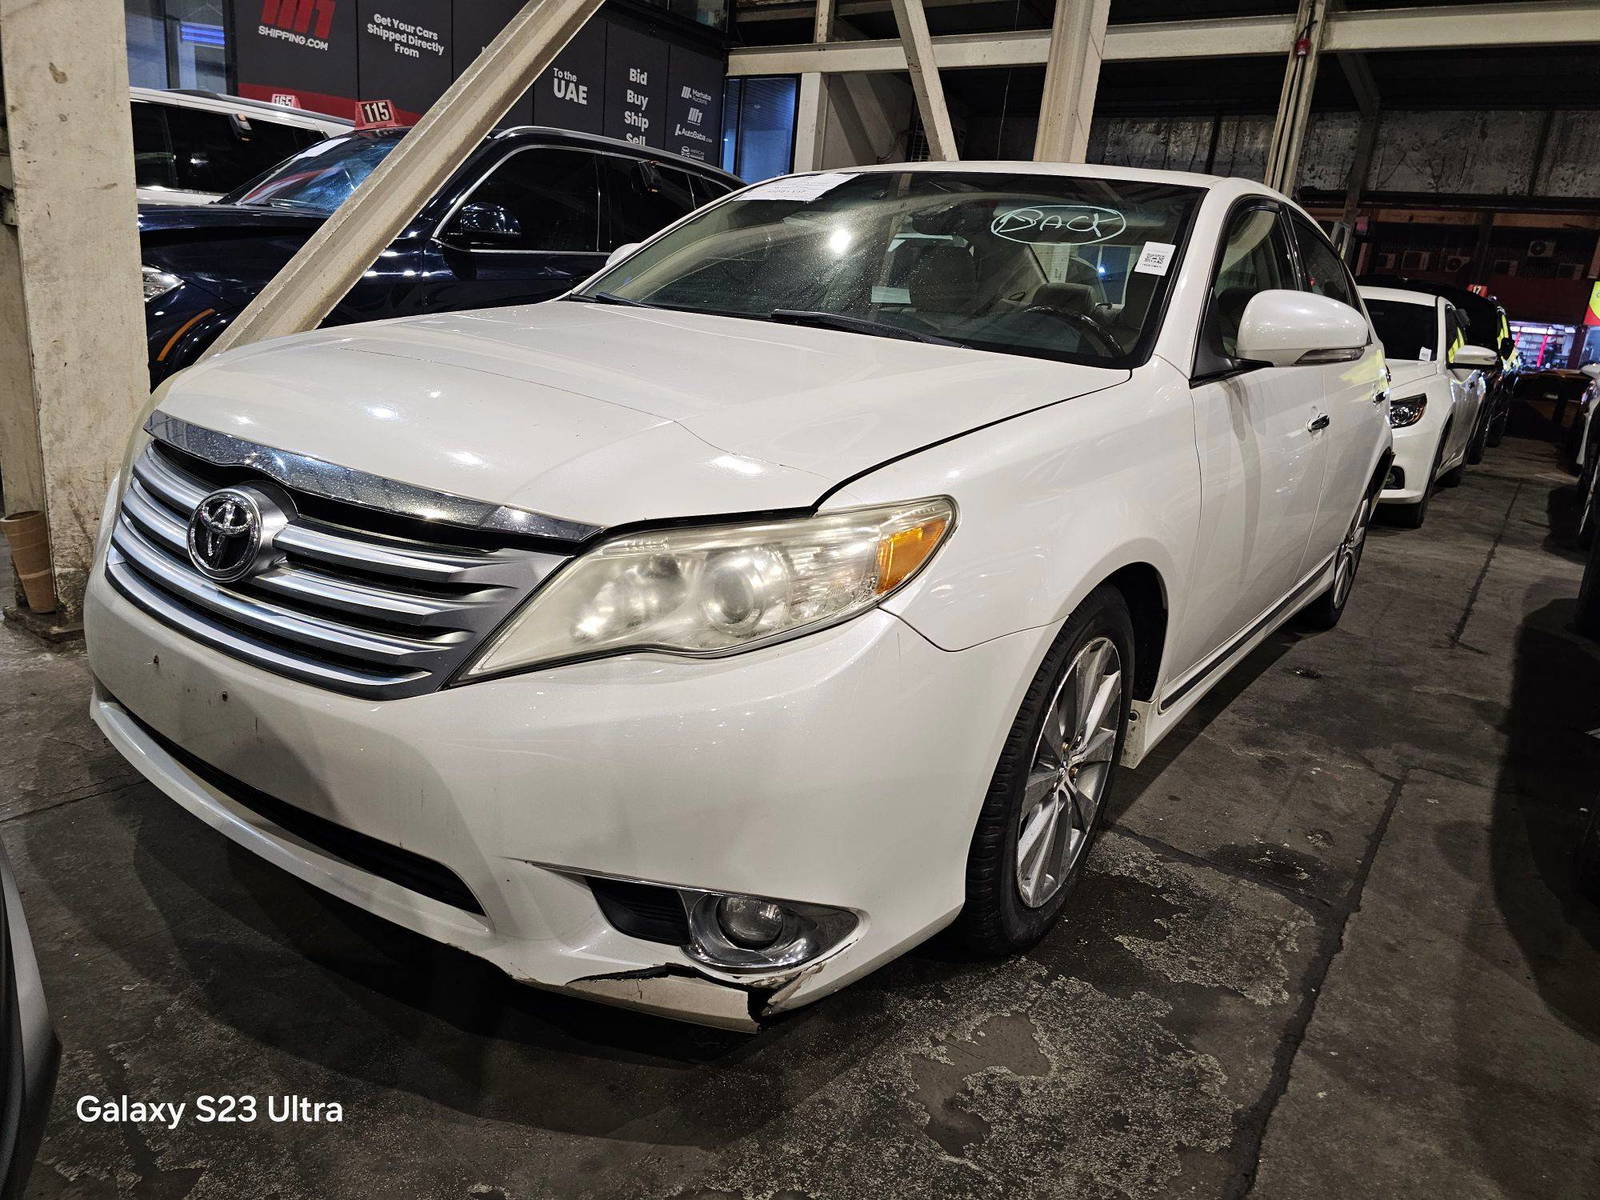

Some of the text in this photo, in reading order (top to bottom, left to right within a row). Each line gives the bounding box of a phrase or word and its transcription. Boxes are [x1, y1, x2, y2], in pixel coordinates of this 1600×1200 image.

[374, 13, 438, 40] Get Your Cars
[258, 25, 329, 51] SHIPPING.COM
[367, 23, 444, 56] Shipped Directly
[394, 43, 419, 58] From
[553, 67, 577, 82] To the
[629, 68, 648, 85] Bid
[553, 78, 588, 105] UAE
[626, 89, 648, 110] Buy
[365, 101, 390, 122] 115
[624, 111, 649, 132] Ship
[626, 133, 646, 146] Sell
